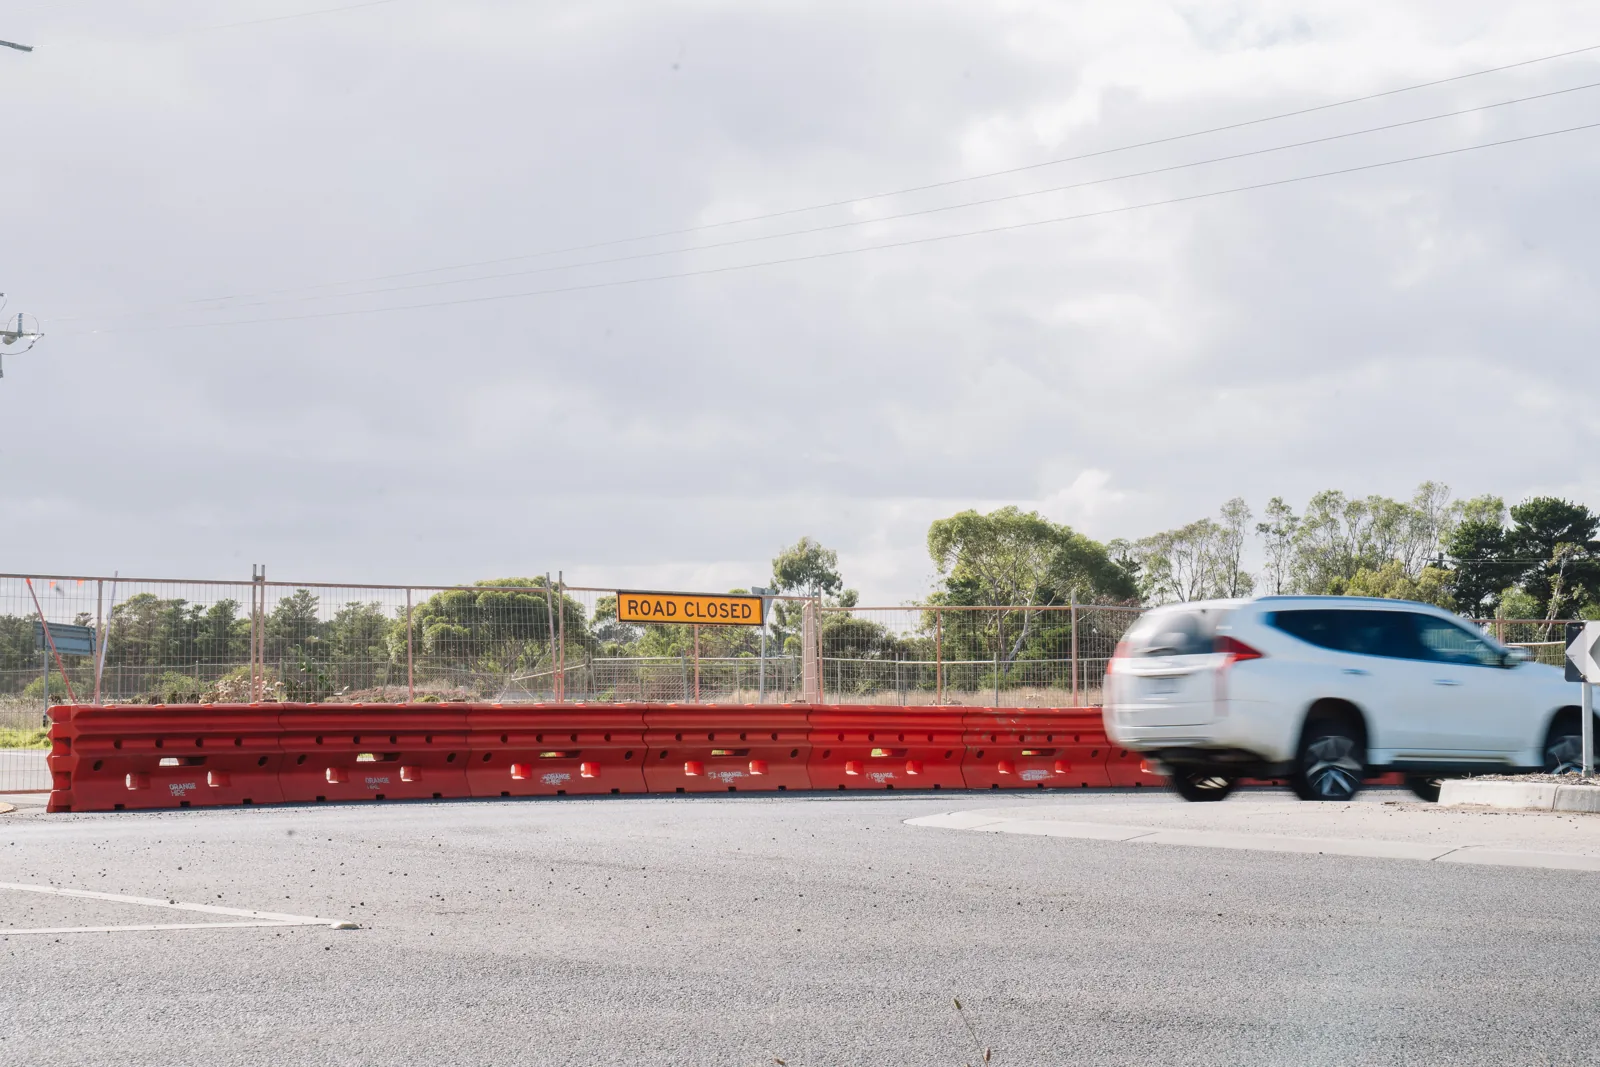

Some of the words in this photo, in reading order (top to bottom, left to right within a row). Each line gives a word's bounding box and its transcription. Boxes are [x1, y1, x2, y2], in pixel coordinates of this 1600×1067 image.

[628, 600, 677, 617] ROAD
[684, 602, 752, 619] CLOSED
[169, 782, 196, 790] ORANGE
